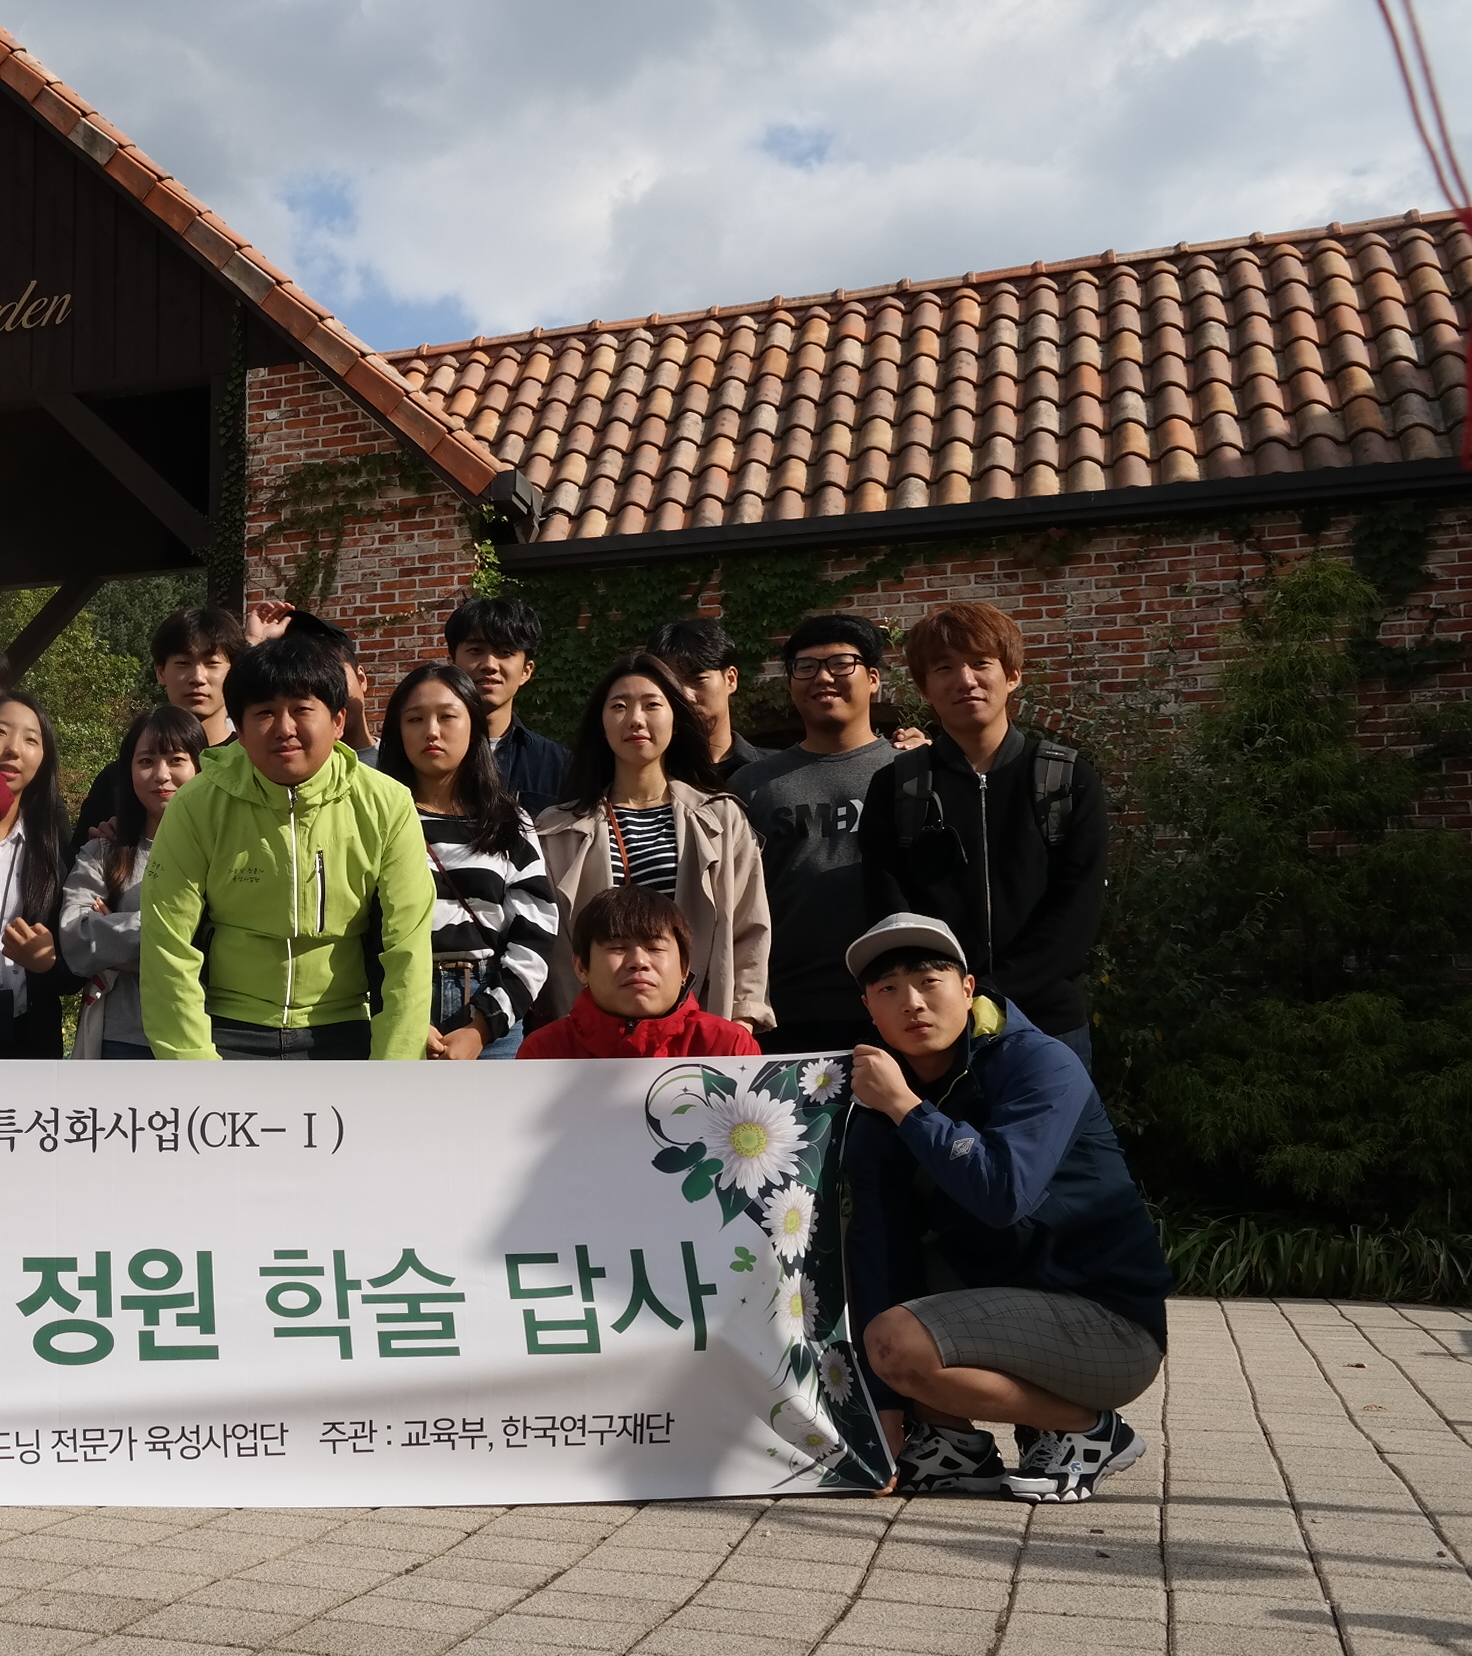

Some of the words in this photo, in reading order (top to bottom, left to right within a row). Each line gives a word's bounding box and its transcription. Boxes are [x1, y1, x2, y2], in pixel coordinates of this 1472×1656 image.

[15, 1248, 220, 1366] 정원
[258, 1248, 466, 1360] 학술
[504, 1240, 718, 1355] 답사
[50, 1426, 137, 1463] 전문가
[143, 1421, 290, 1460] 육성사업단
[319, 1419, 378, 1455] 주관
[400, 1416, 494, 1453] 교육부,
[500, 1411, 676, 1449] 한국연구재단
